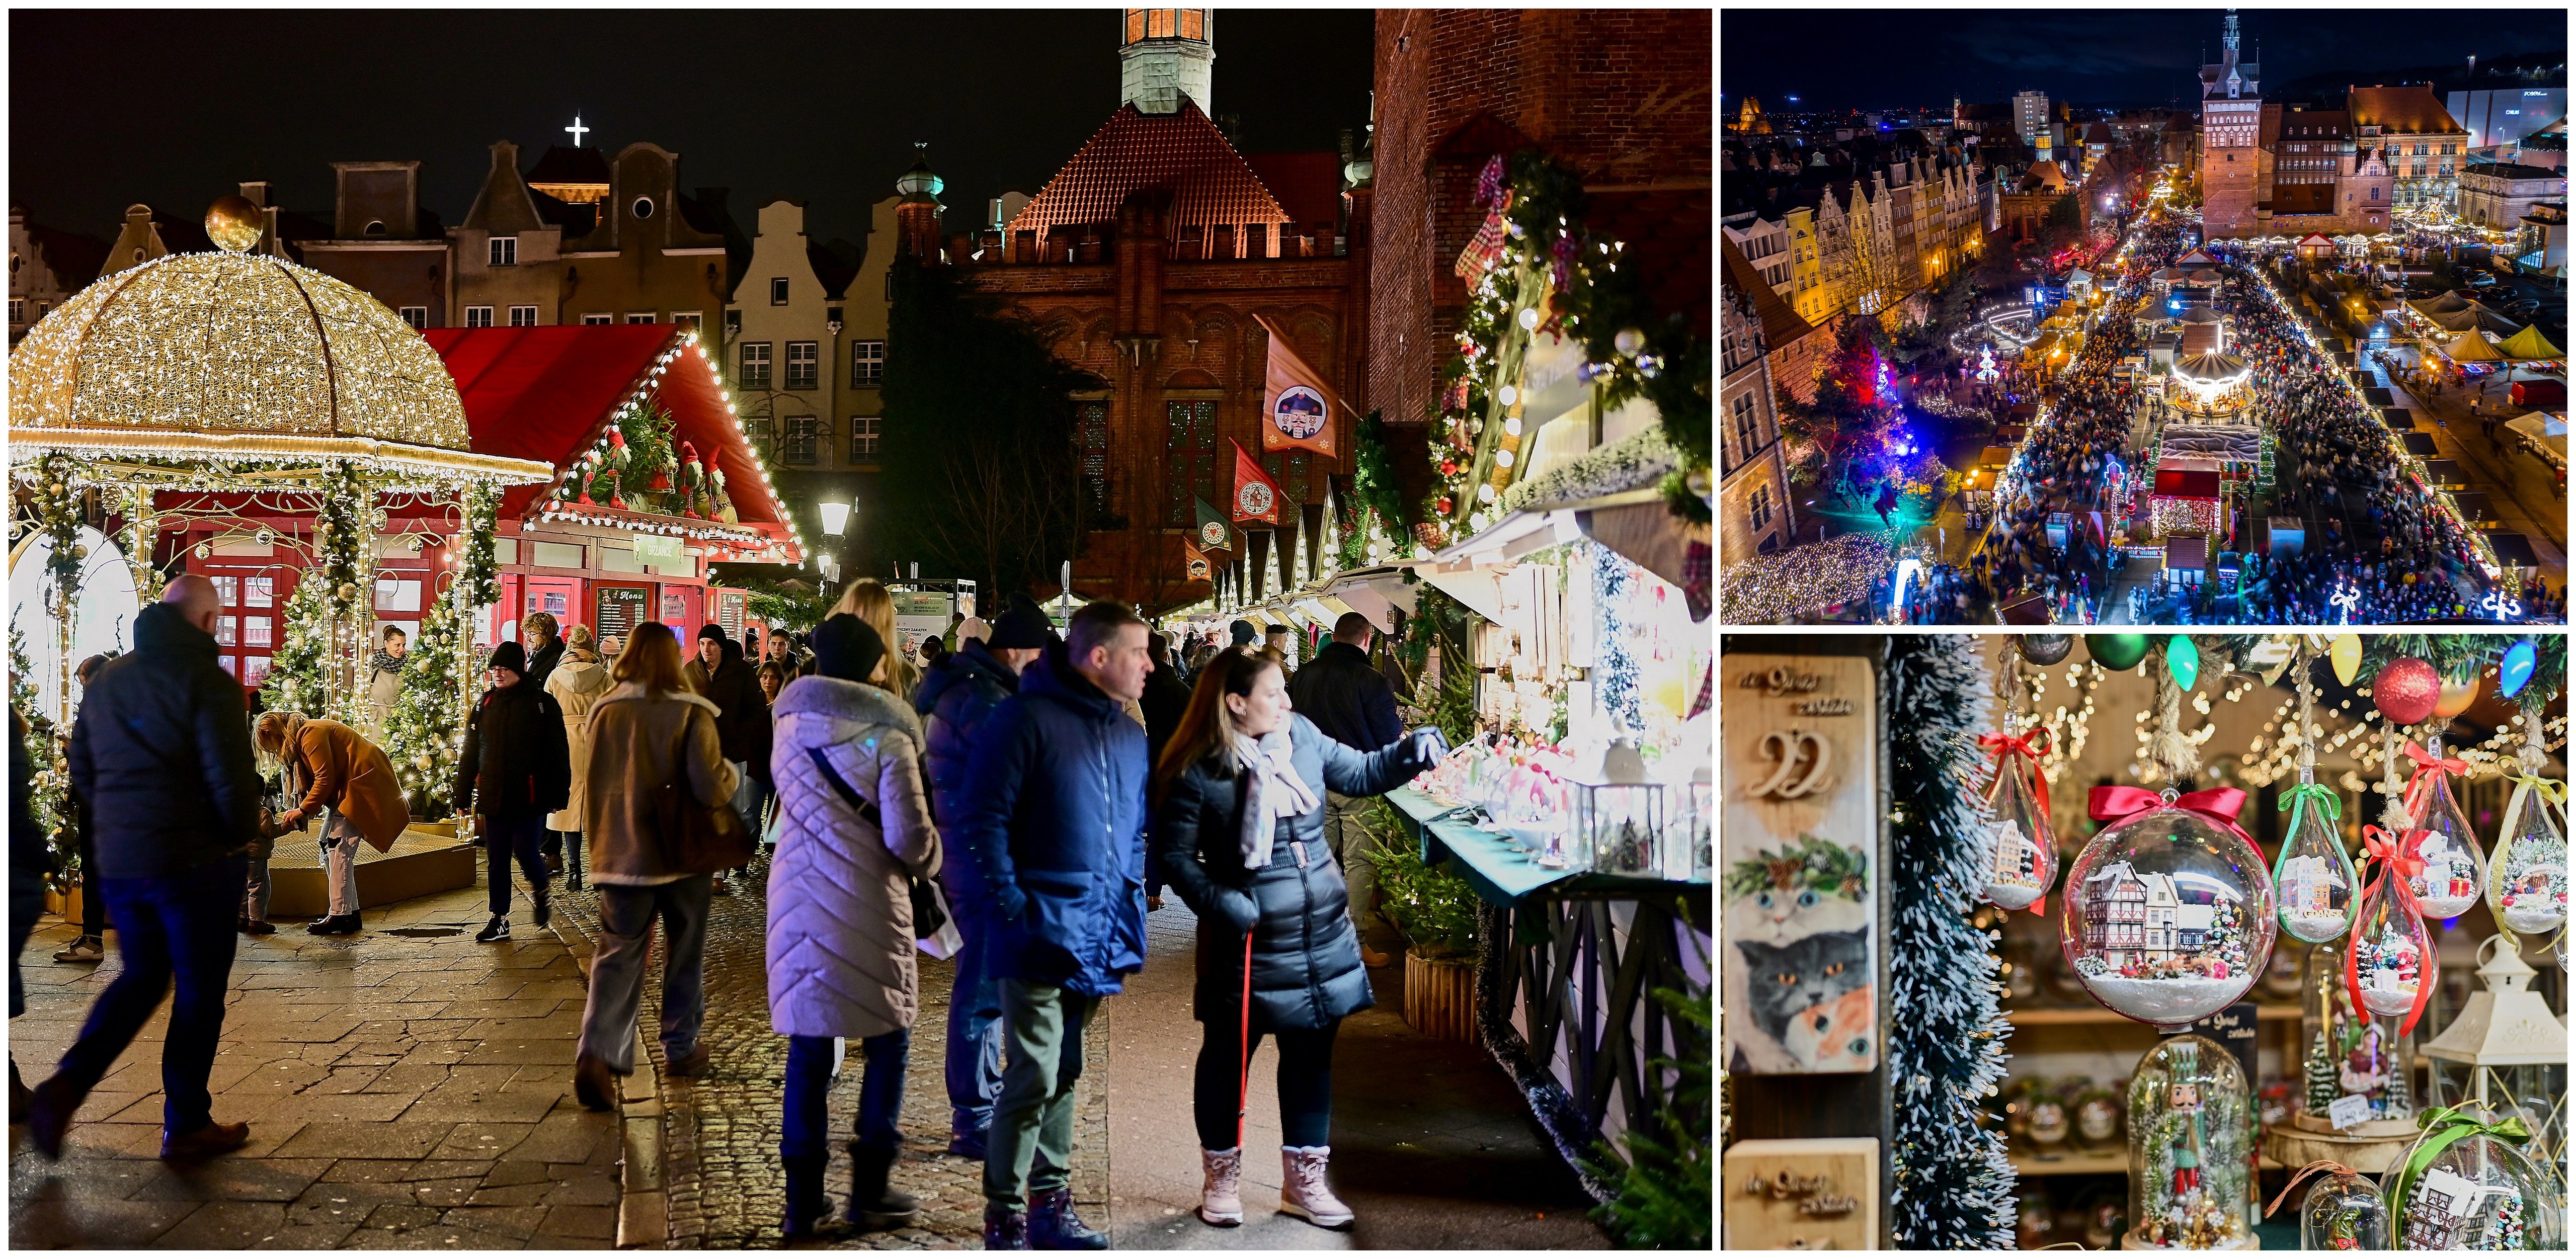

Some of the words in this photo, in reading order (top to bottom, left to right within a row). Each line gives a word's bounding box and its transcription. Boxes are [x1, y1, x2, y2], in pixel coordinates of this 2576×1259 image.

[648, 544, 672, 557] GRZAŃCE
[619, 591, 643, 600] Menu
[1746, 730, 1835, 799] 22
